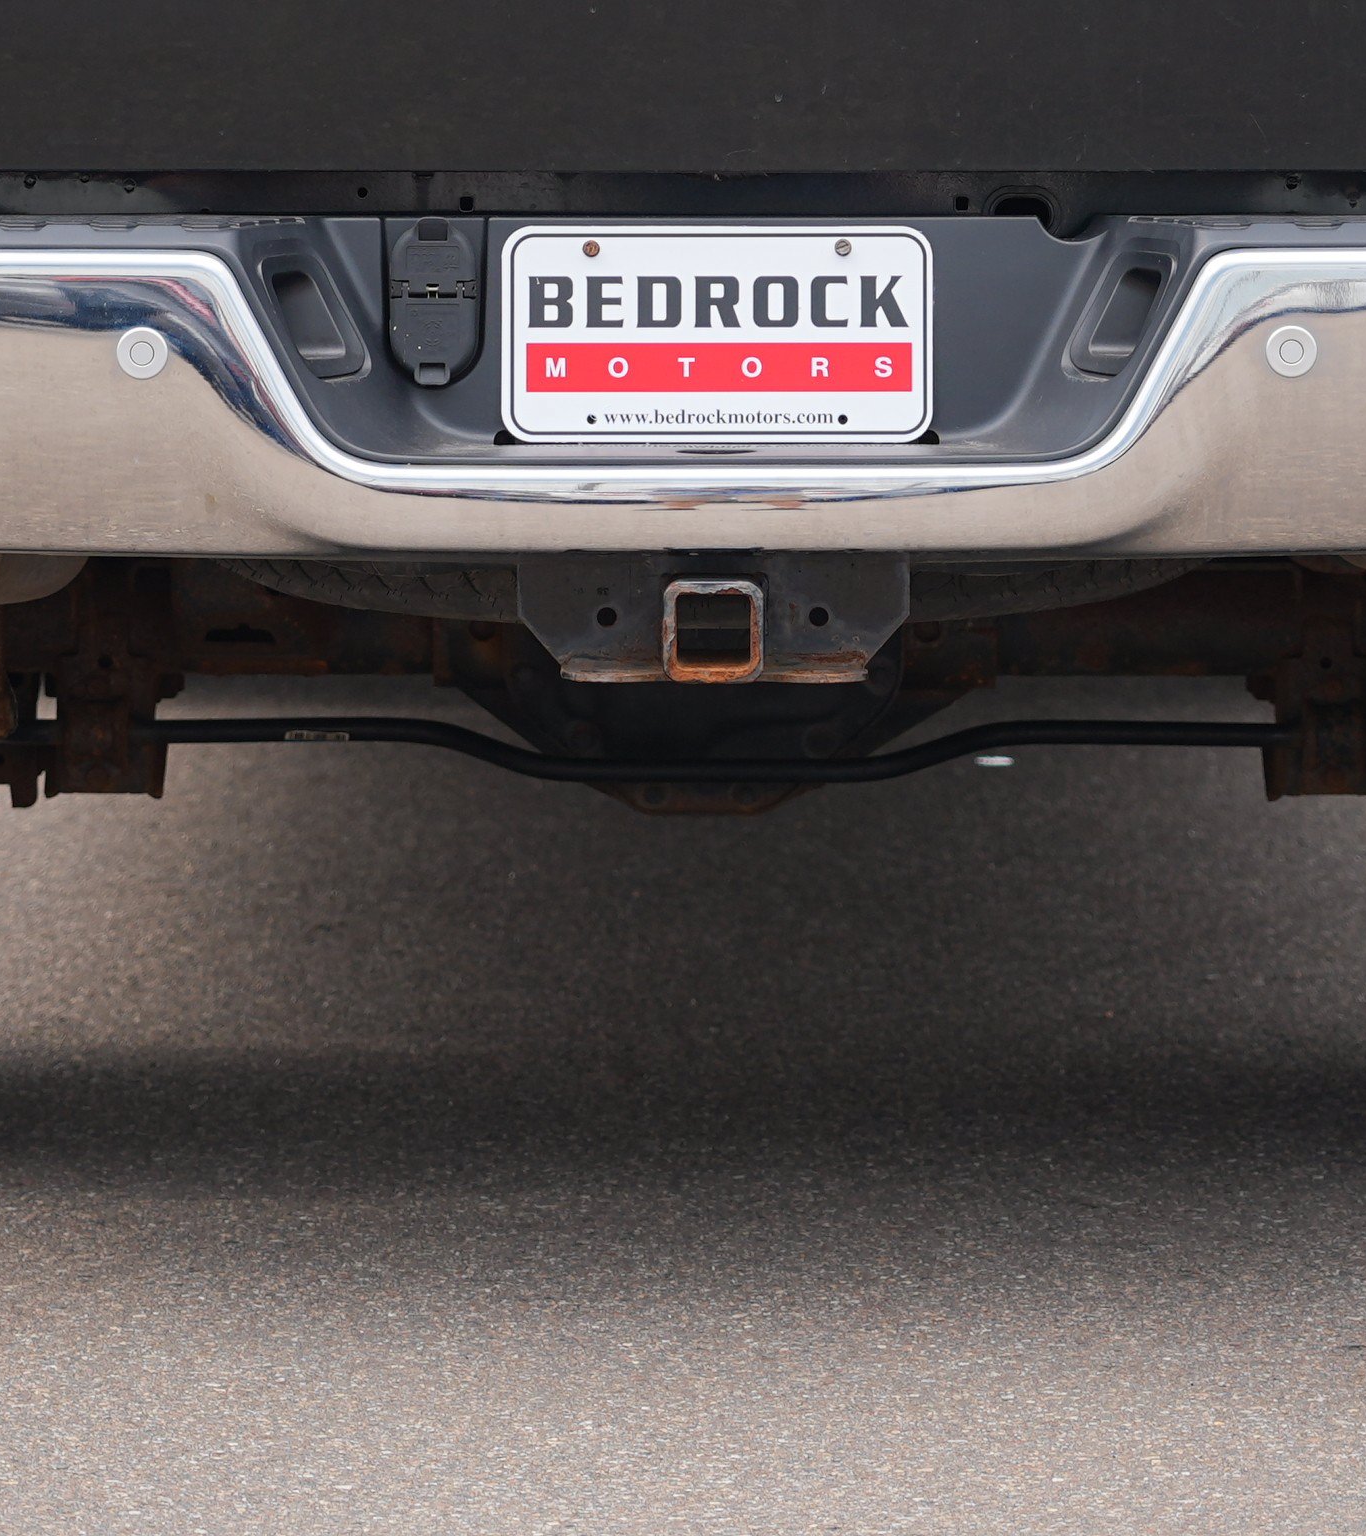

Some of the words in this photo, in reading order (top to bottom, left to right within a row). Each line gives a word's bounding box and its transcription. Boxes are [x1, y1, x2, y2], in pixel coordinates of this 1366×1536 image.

[528, 275, 910, 328] BEDROCK
[545, 356, 894, 379] MOTORS
[604, 409, 834, 425] www.bedrockmotors.com
